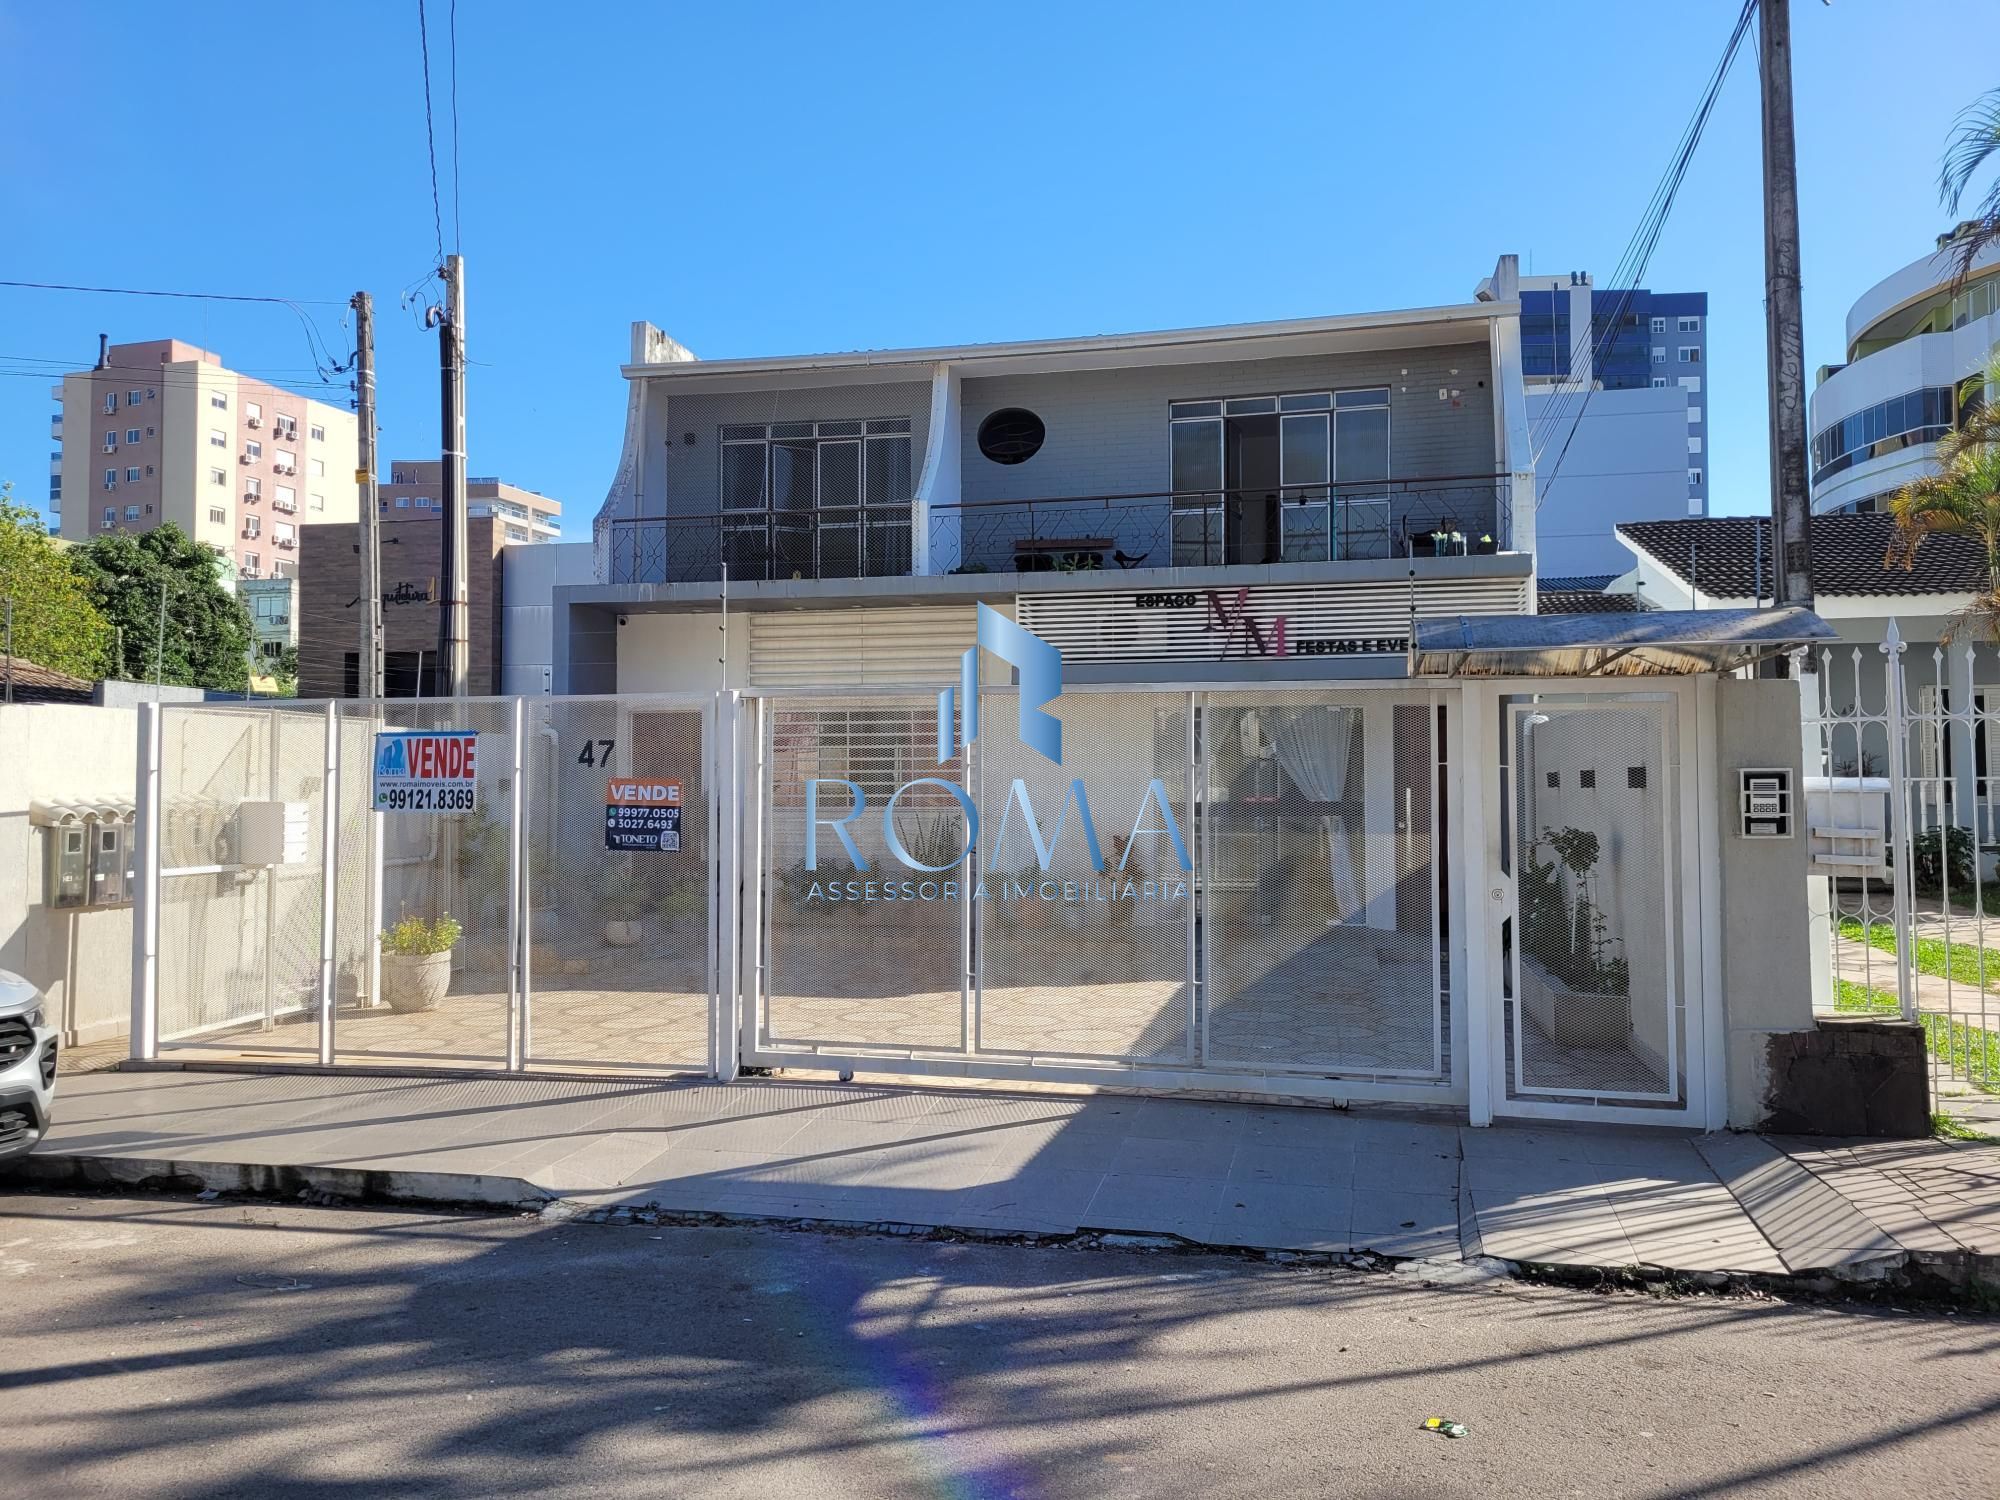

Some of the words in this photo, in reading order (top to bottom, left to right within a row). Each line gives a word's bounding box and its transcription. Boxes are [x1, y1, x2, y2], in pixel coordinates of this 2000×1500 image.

[1296, 640, 1356, 655] FESTAS
[1362, 640, 1372, 653] E
[1377, 639, 1409, 652] EVE
[407, 738, 475, 778] VENDE
[578, 740, 614, 767] 47
[389, 789, 473, 809] 99121.8369
[611, 785, 679, 800] VENDE
[618, 808, 679, 817] 99977.0505
[618, 819, 672, 828] 3027.6493
[621, 834, 657, 843] TONETO
